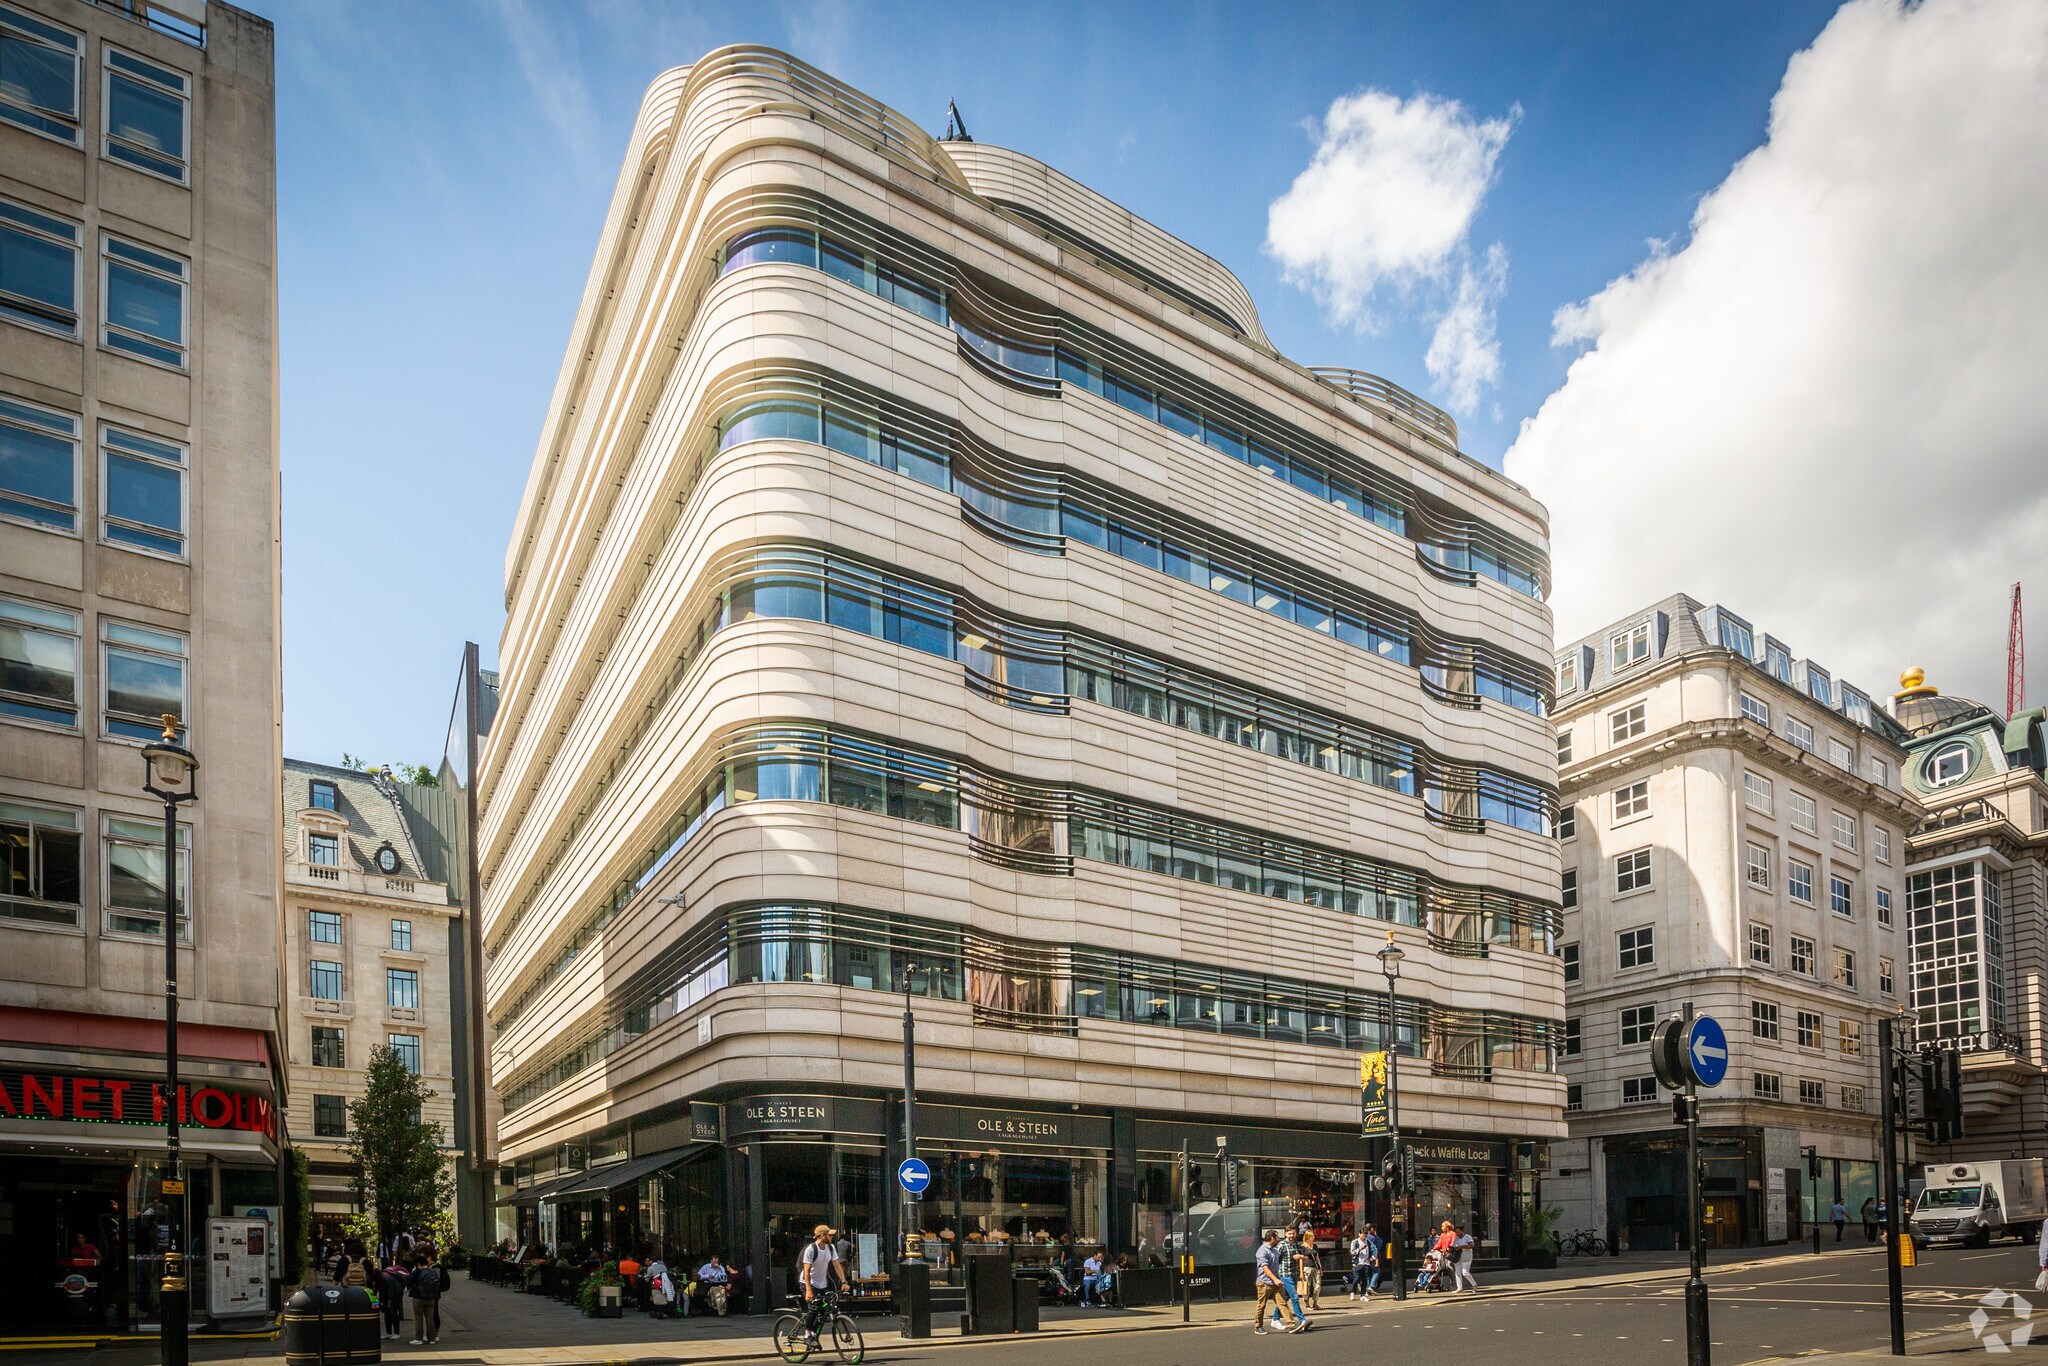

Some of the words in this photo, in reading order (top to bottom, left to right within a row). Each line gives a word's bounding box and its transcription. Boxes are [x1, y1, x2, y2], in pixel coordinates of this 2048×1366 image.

[746, 1107, 764, 1119] OLE
[767, 1106, 776, 1118] &
[780, 1106, 825, 1118] STEEN
[1364, 1111, 1387, 1127] Tina
[977, 1119, 1002, 1131] OLE
[1006, 1121, 1014, 1133] &
[1018, 1122, 1058, 1135] STEEN
[1431, 1148, 1437, 1158] &
[1437, 1146, 1466, 1160] Waffle
[1468, 1148, 1491, 1161] Local
